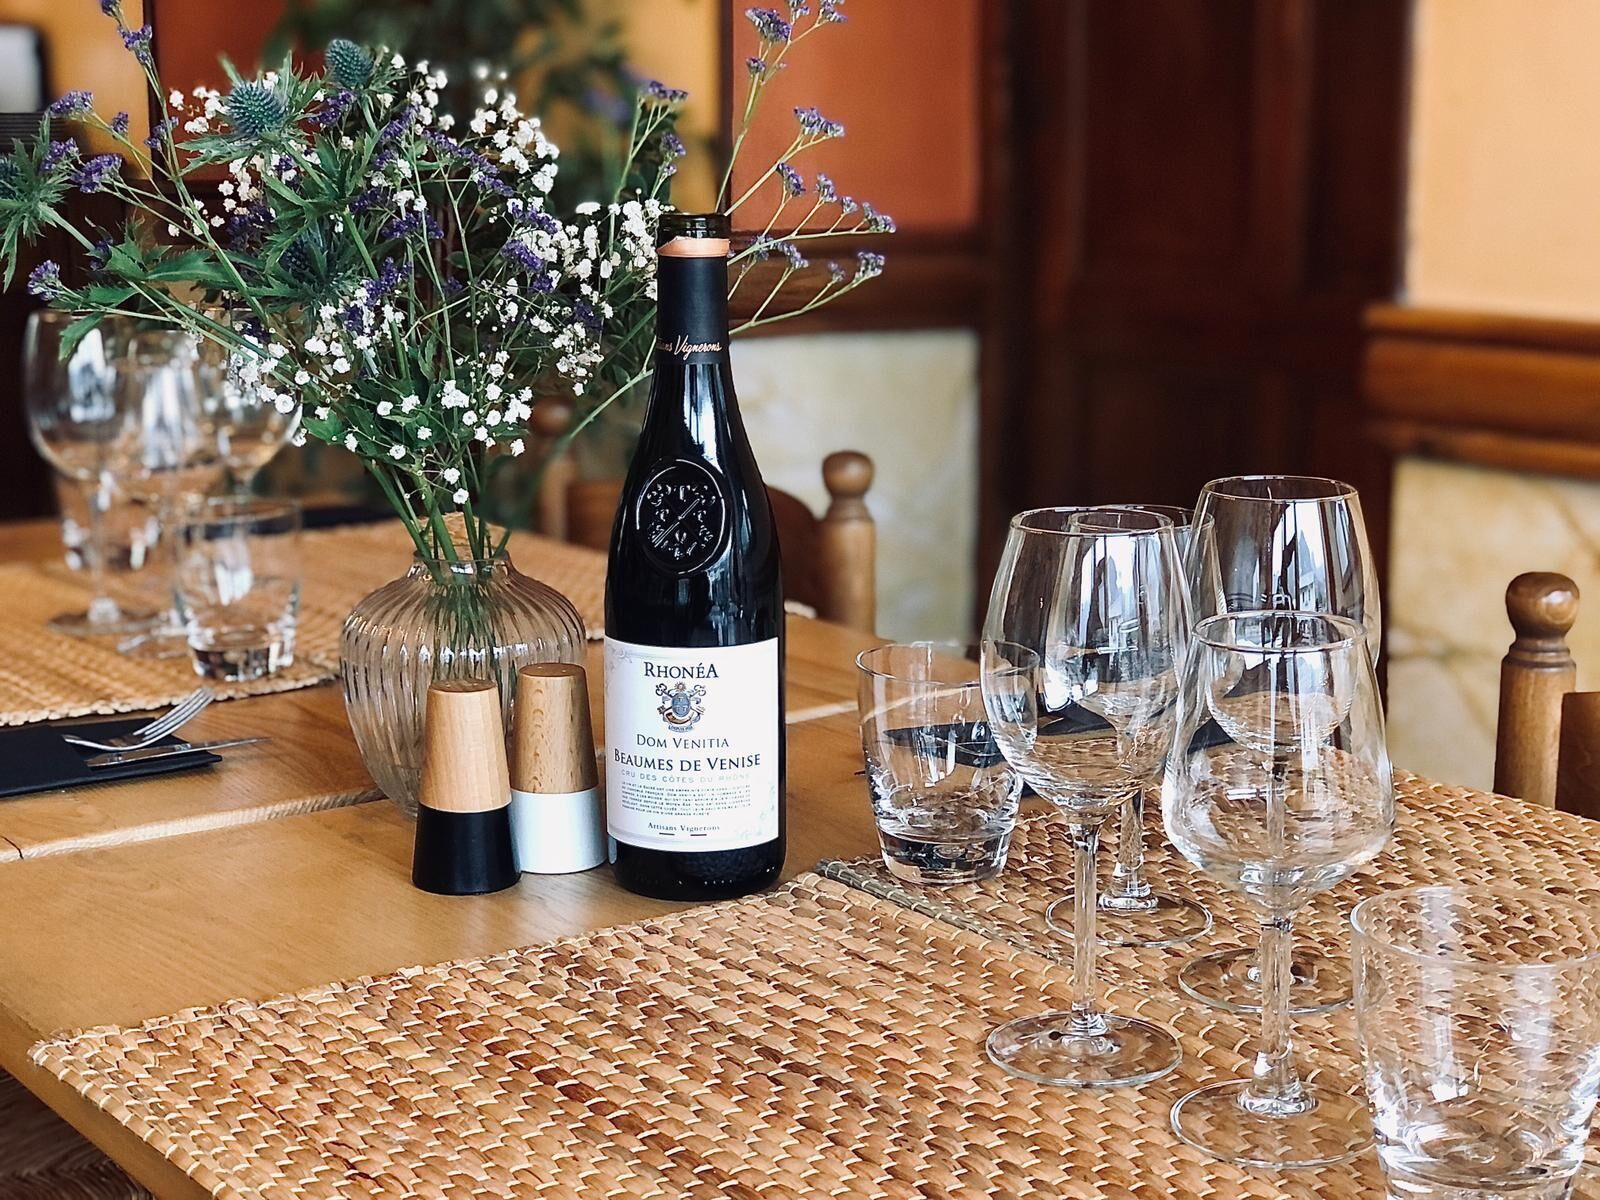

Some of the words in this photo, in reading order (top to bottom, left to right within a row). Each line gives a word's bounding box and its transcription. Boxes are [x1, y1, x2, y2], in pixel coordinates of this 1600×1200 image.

[674, 334, 722, 360] Vignerons
[643, 661, 719, 679] RHONÉA
[636, 734, 667, 749] DOM
[672, 737, 729, 750] VENITIA
[614, 748, 674, 771] BEAUMES
[679, 759, 701, 772] DE
[706, 753, 761, 770] VENISE
[639, 773, 657, 782] DES
[647, 822, 677, 832] Artisans
[680, 825, 720, 834] Vignerons
